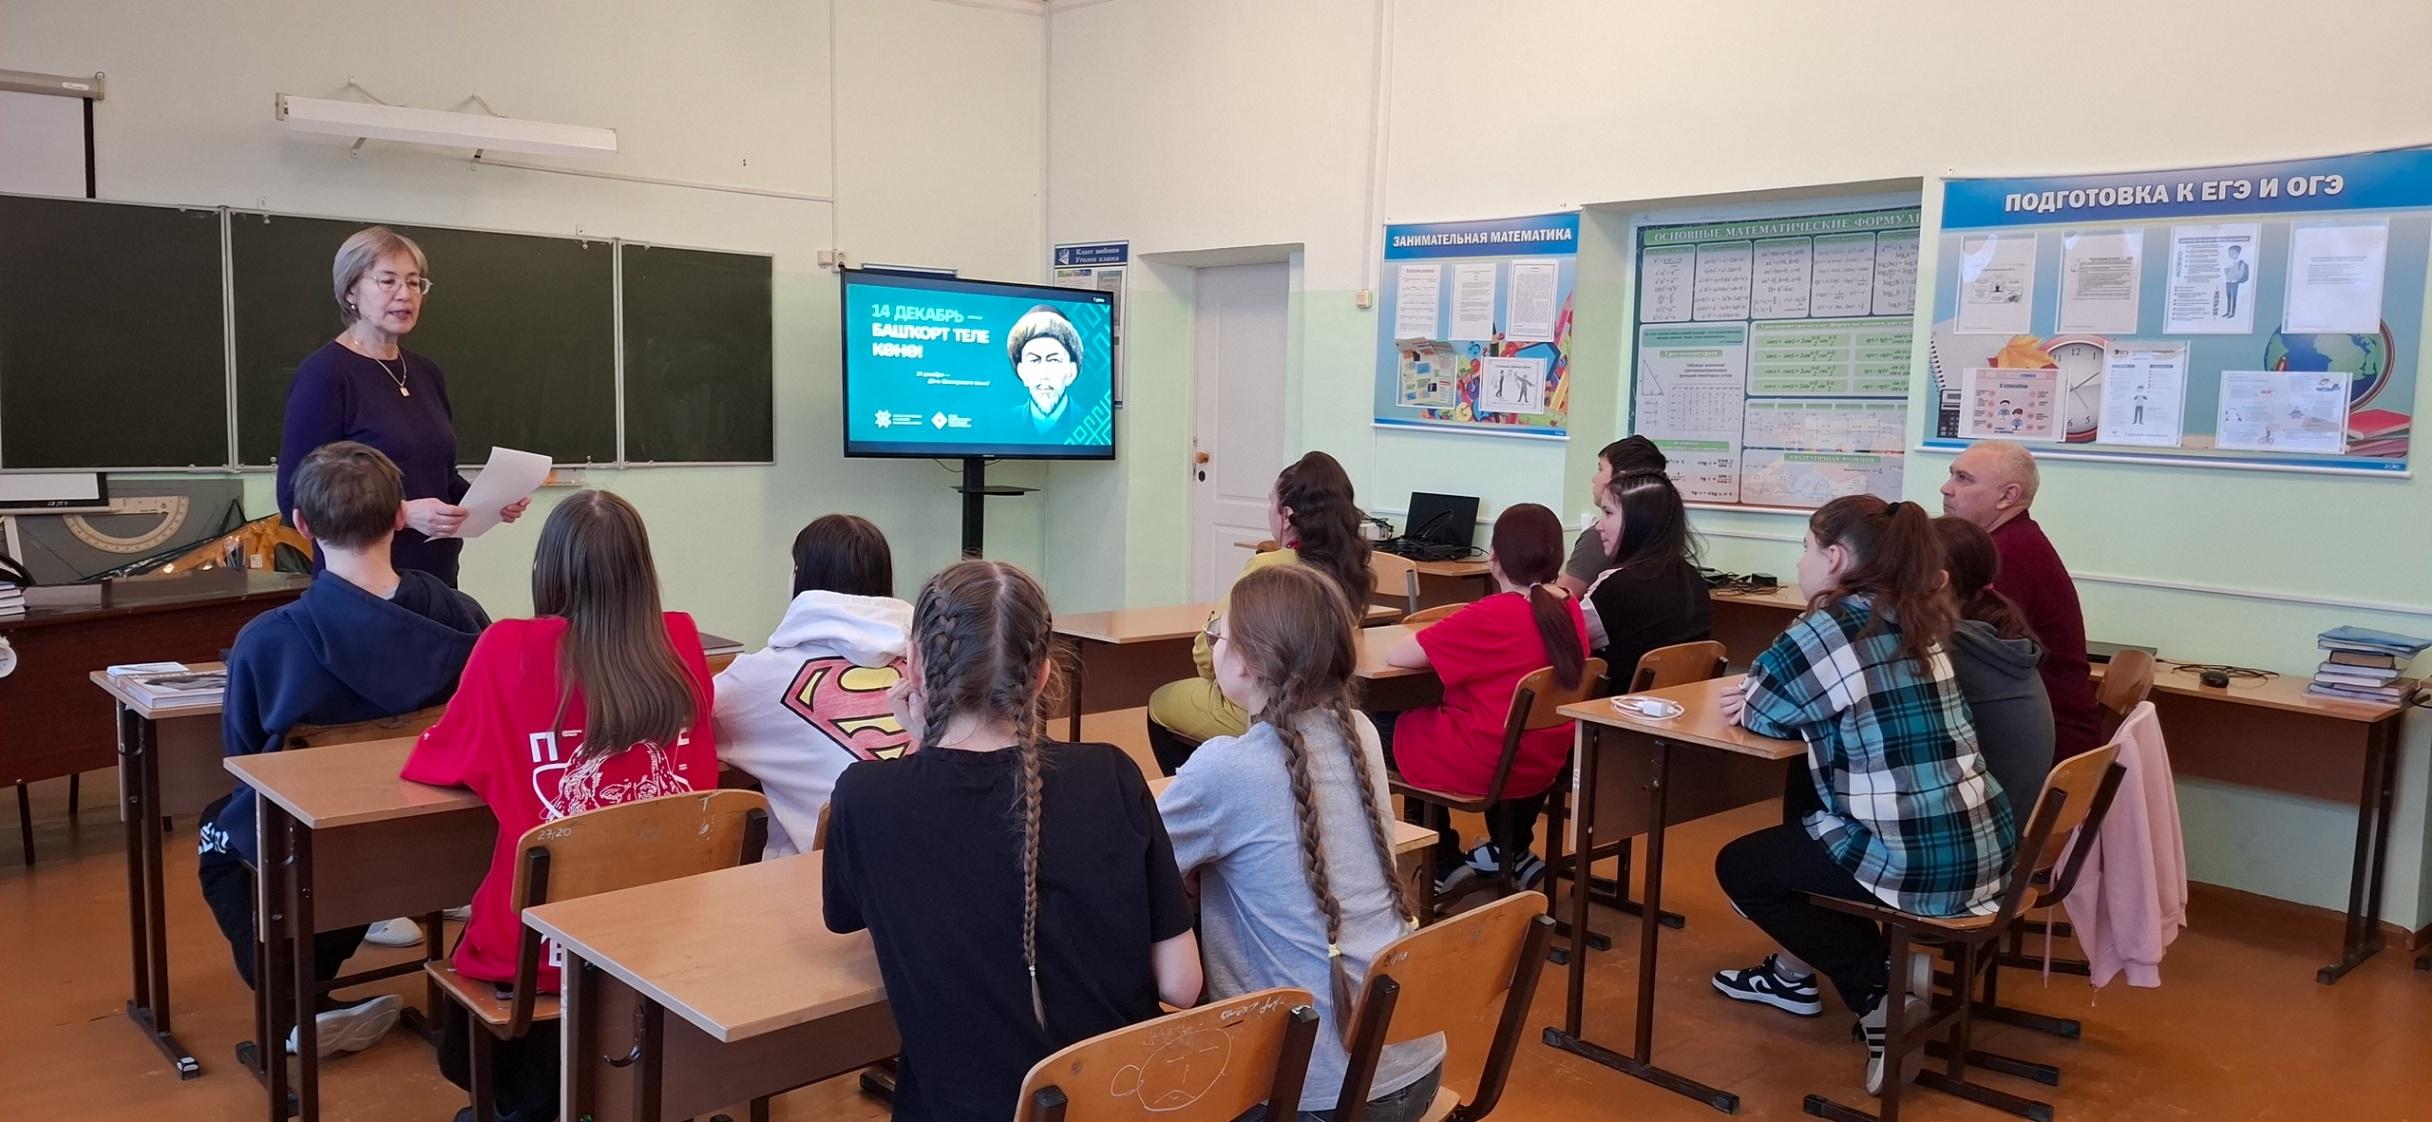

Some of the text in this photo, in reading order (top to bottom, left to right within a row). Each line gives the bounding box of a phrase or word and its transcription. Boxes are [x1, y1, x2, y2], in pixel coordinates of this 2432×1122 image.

[2004, 174, 2344, 213] ПОДГОТОВКА К ЕГЭ И ОГЭ
[1392, 228, 1572, 248] ЗАНИМАТЕЛЬНАЯ МАТЕМАТИКА
[1654, 228, 1721, 242] ОСНОВНЫЕ
[1725, 219, 1849, 237] МАТЕМАТИЧЕСКИЕ
[871, 304, 890, 318] 14
[894, 305, 964, 323] ДЕКАБРЬ
[953, 327, 990, 344] ТЕЛЕ
